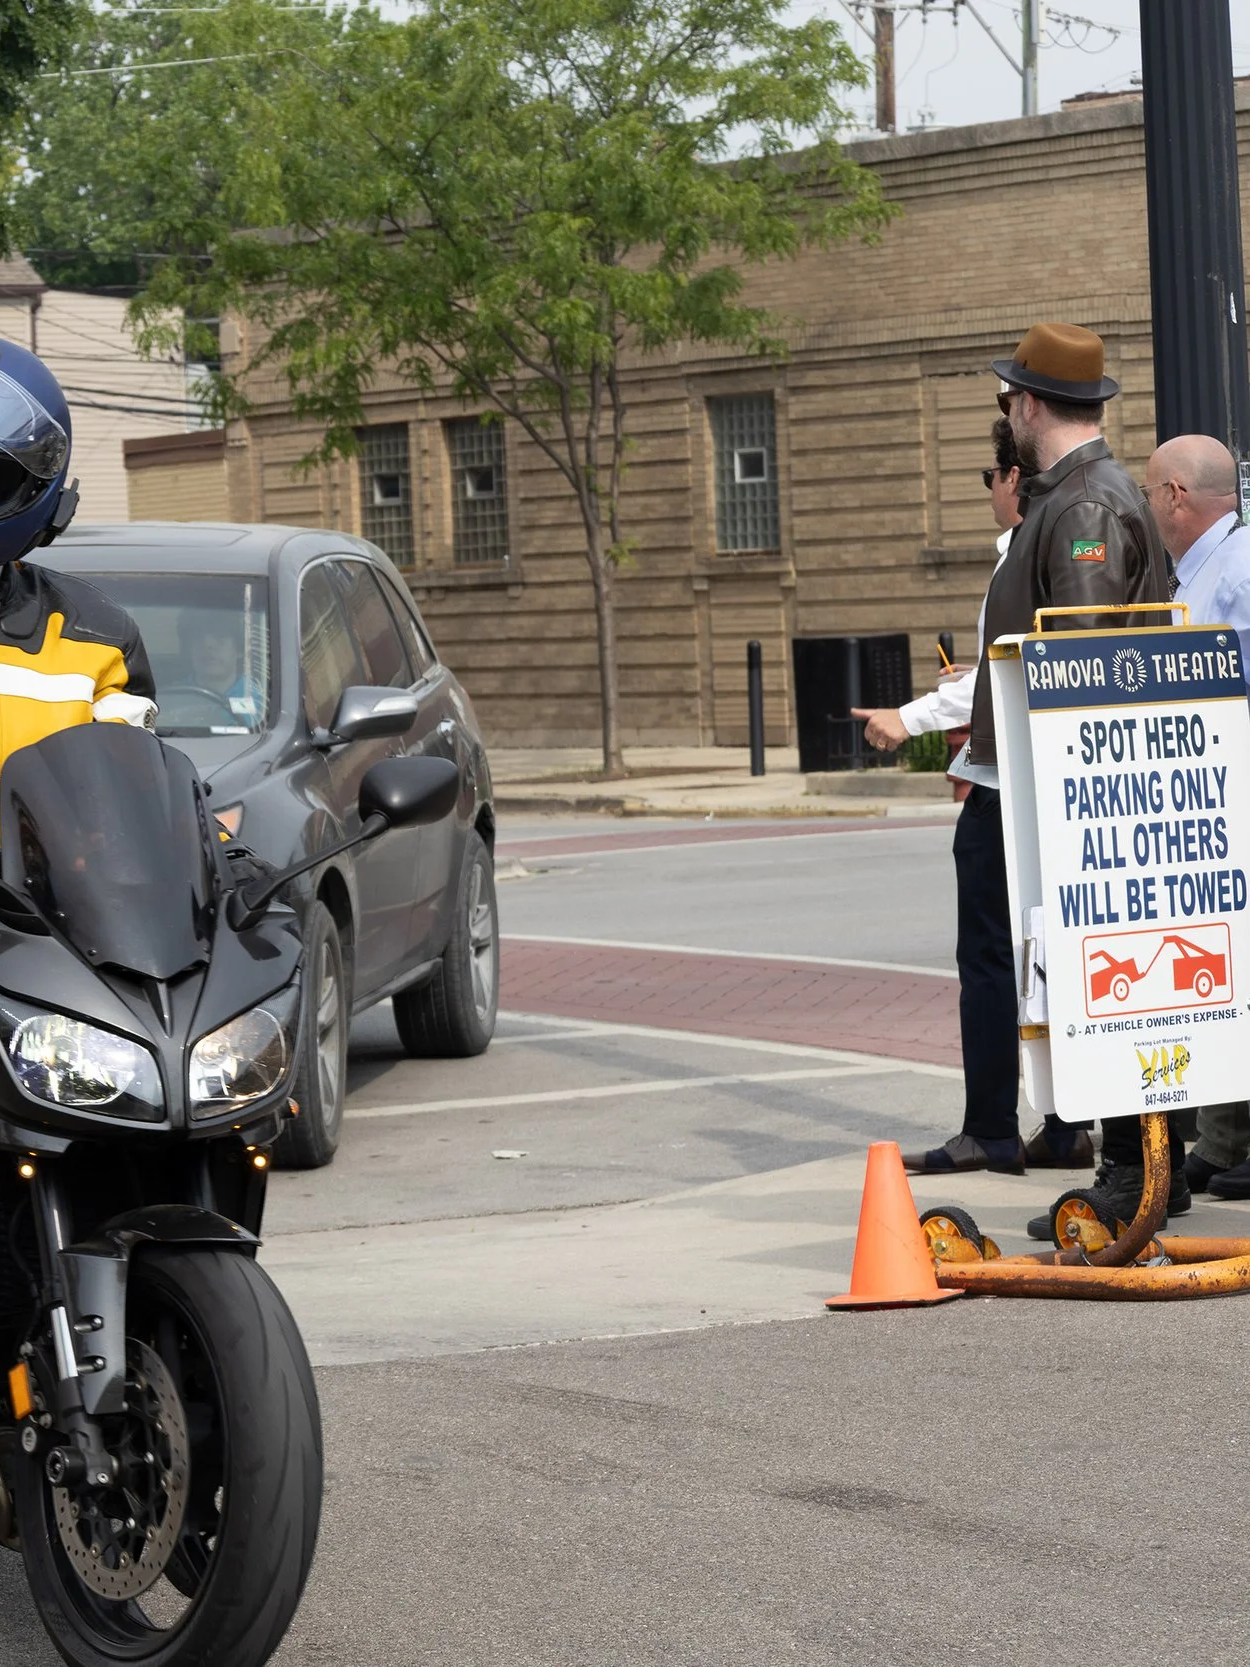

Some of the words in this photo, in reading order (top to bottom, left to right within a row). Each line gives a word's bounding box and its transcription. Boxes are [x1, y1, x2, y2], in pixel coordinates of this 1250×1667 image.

[1073, 547, 1103, 556] AGV
[1027, 657, 1106, 691] RAMOVA
[1151, 650, 1240, 683] THEATRE
[1079, 718, 1137, 765] SPOT
[1144, 713, 1206, 760] HERO
[1063, 770, 1164, 821] PARKING
[1170, 766, 1227, 812] ONLY
[1081, 826, 1127, 871] ALL
[1133, 816, 1229, 867] OTHERS
[1058, 881, 1119, 928] WILL
[1126, 877, 1158, 921] BE
[1163, 868, 1247, 917] TOWED
[1084, 1024, 1097, 1036] AT
[1100, 1019, 1143, 1034] VEHICLE
[1146, 1014, 1190, 1028] OWNER'S
[1193, 1008, 1237, 1023] EXPENSE
[1134, 1039, 1152, 1047] Parking
[1162, 1036, 1183, 1044] Managed
[1141, 1051, 1192, 1090] Services
[1145, 1089, 1188, 1106] 847-464-5271
